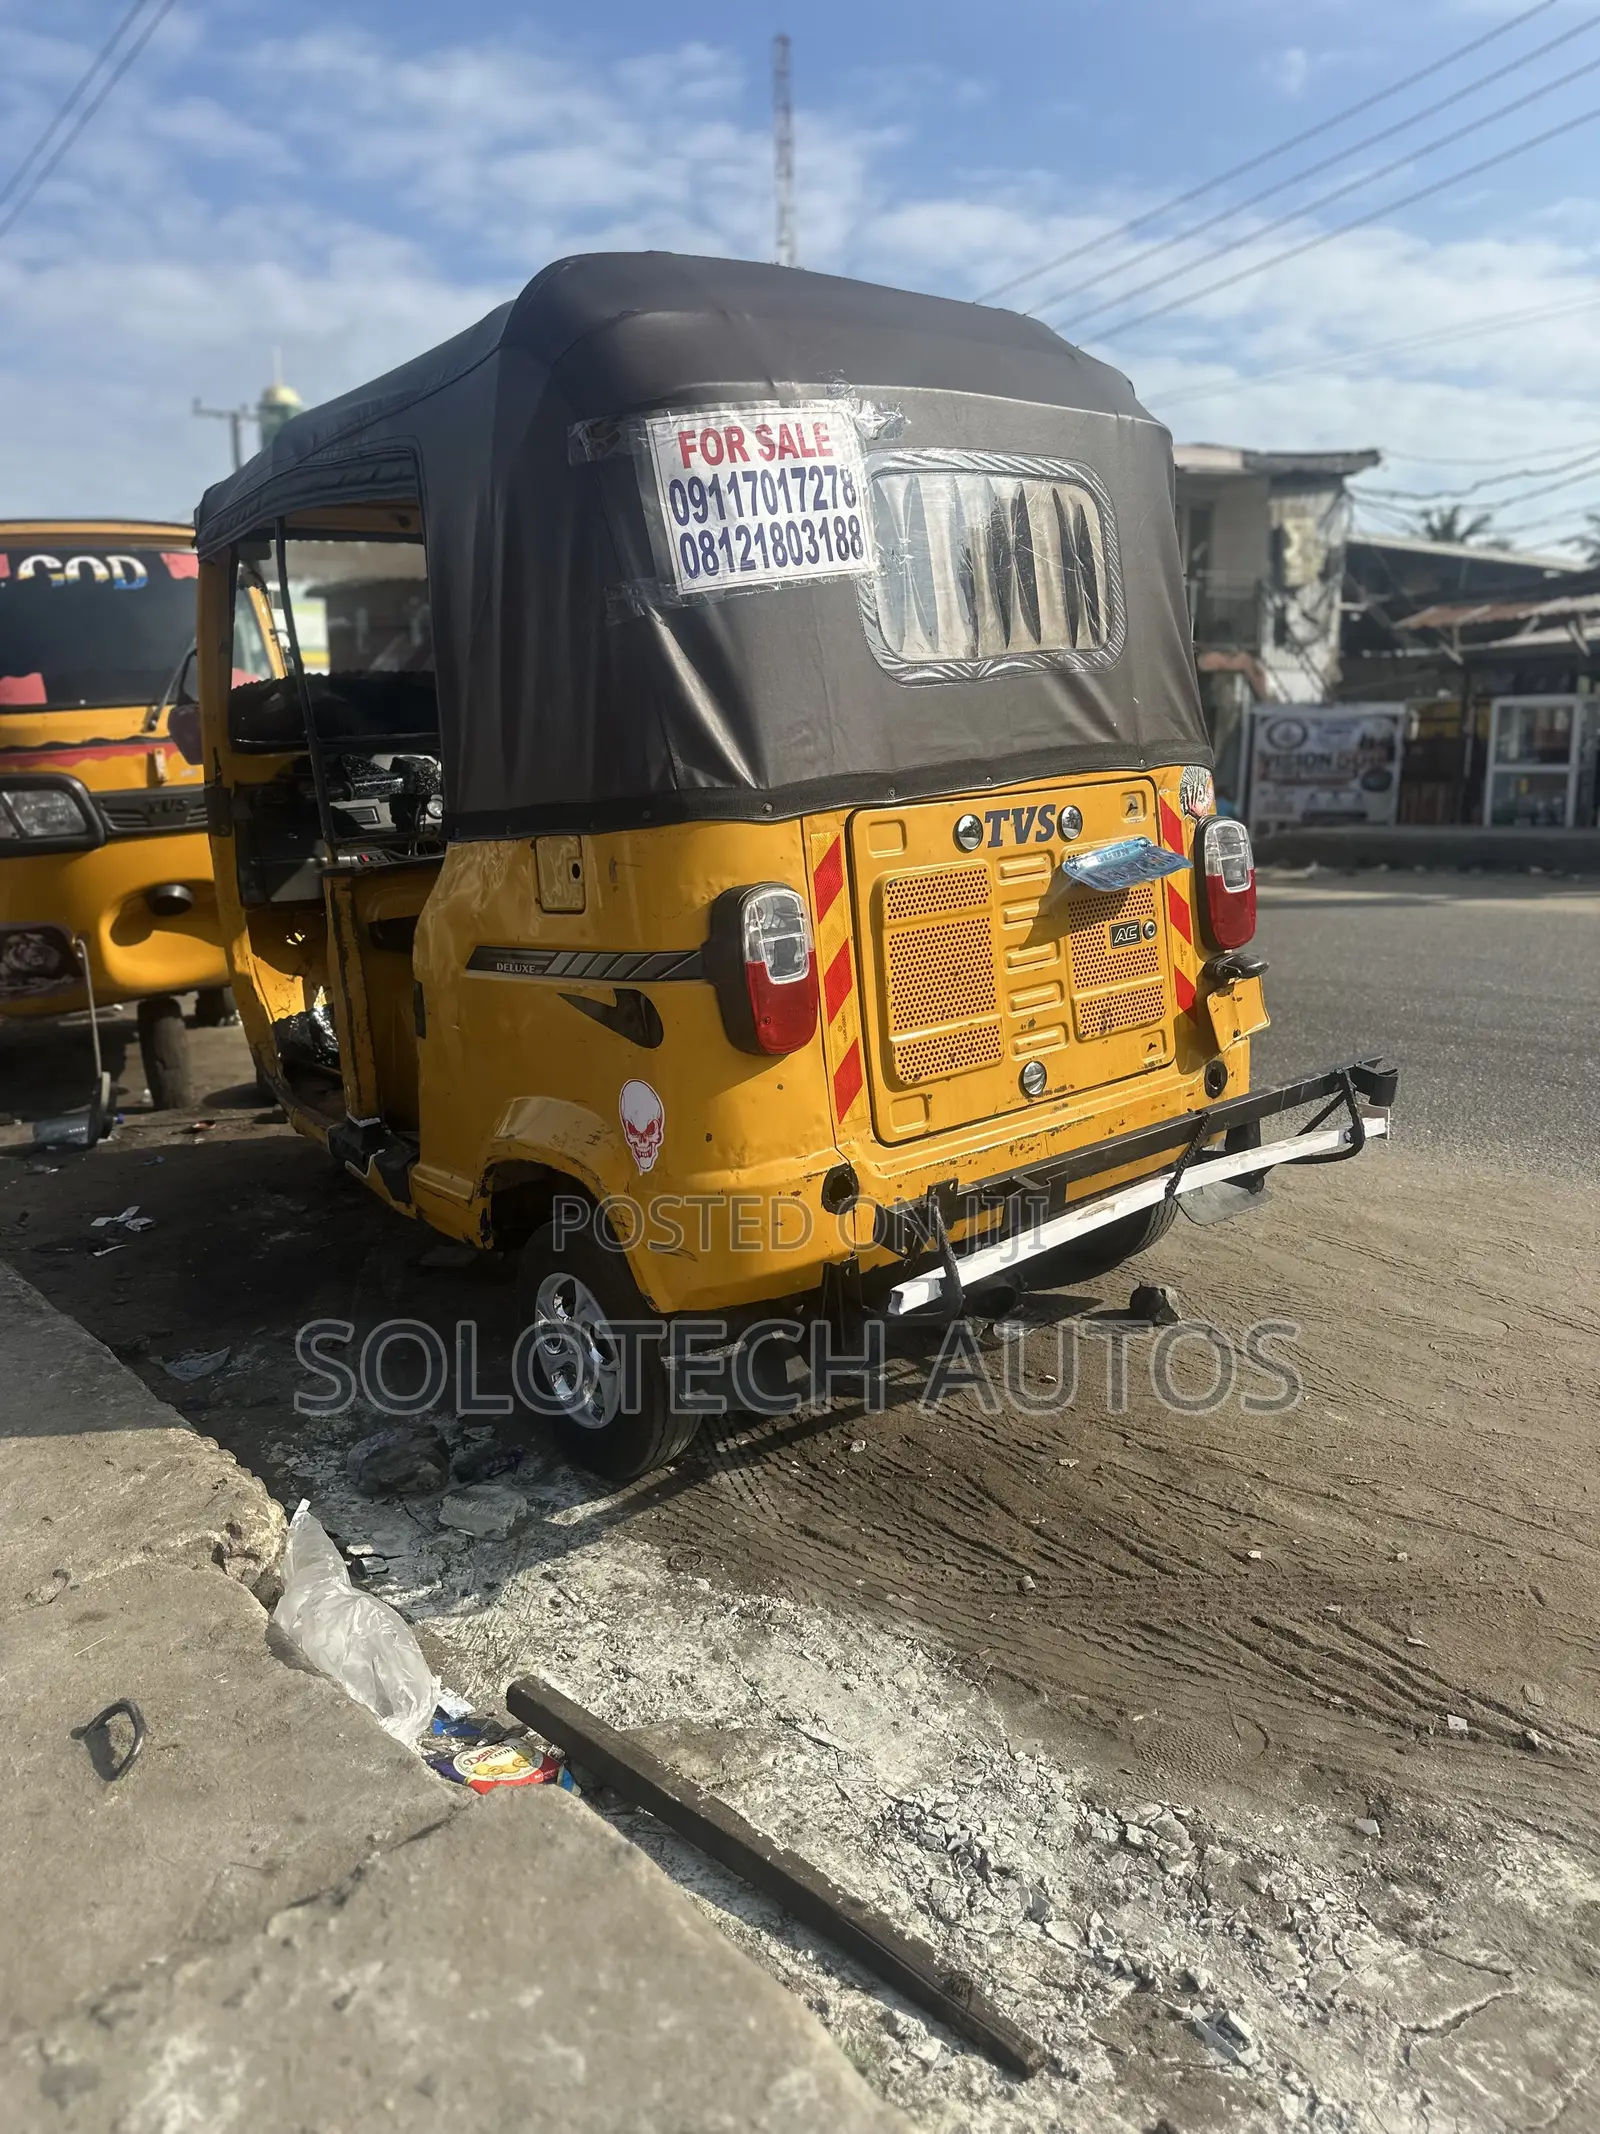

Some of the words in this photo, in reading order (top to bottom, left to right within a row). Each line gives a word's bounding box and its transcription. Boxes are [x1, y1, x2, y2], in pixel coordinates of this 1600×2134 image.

[678, 426, 751, 469] FOR
[755, 422, 834, 462] SALE
[669, 464, 857, 527] 09117017278
[679, 515, 865, 580] 08121803188
[984, 804, 1057, 848] TVS
[1113, 924, 1138, 944] AC
[496, 961, 536, 974] DELUXE
